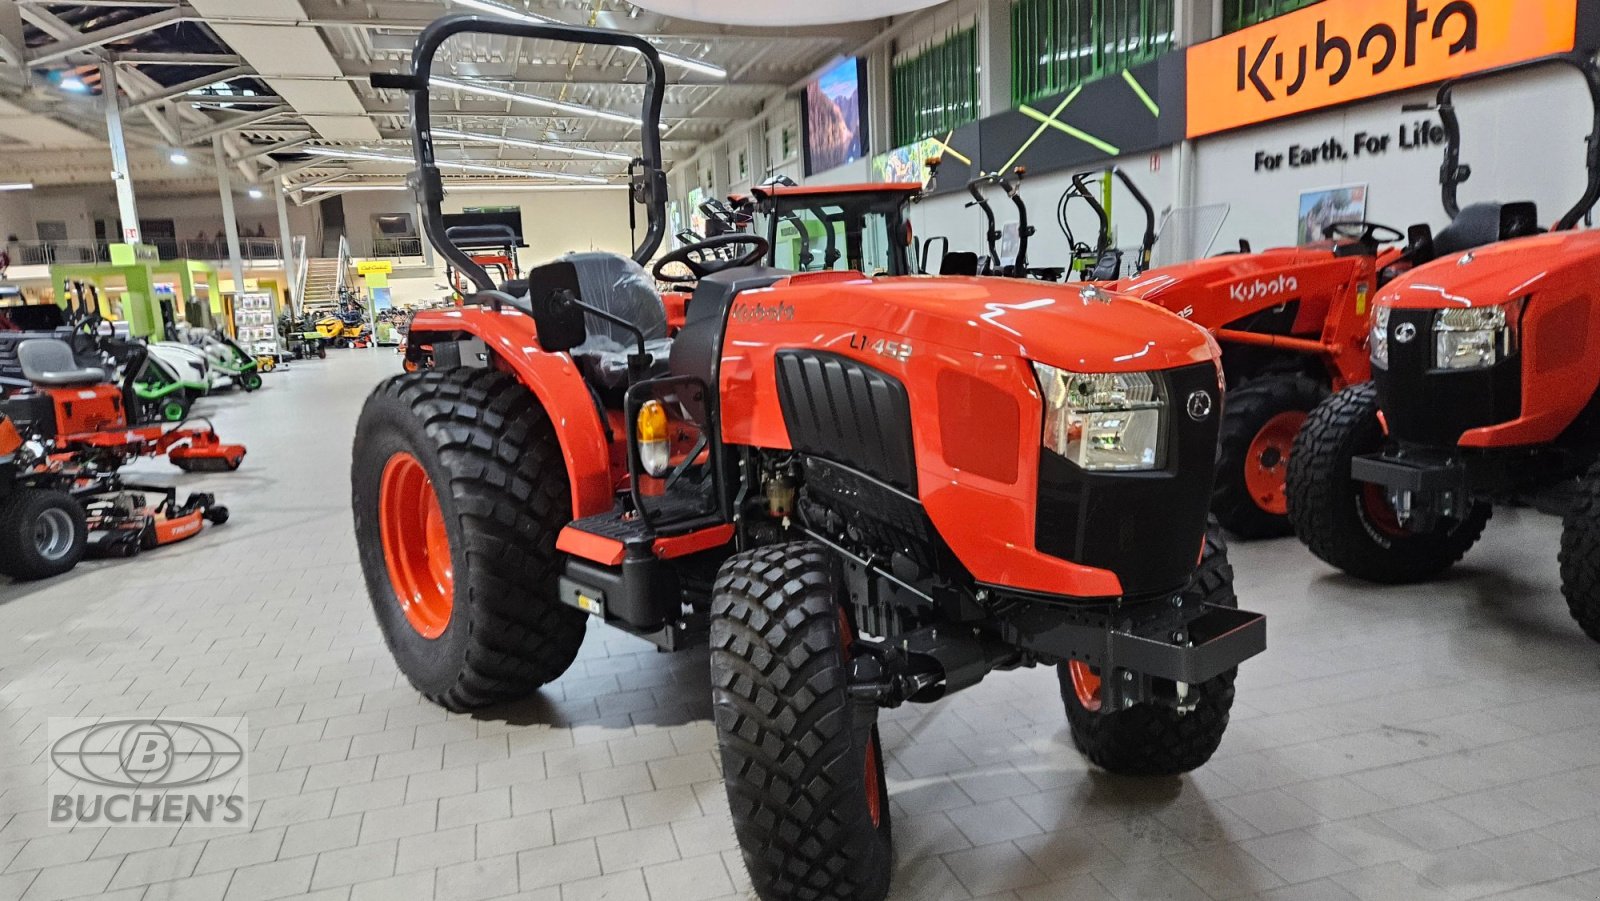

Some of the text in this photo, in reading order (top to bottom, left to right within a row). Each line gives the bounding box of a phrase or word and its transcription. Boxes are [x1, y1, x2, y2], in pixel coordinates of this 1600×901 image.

[1237, 0, 1478, 102] Kubota
[1254, 151, 1283, 172] For
[1288, 137, 1348, 167] Earth,
[1354, 132, 1390, 155] For
[1229, 274, 1298, 302] Kubota
[731, 300, 795, 322] Kubota
